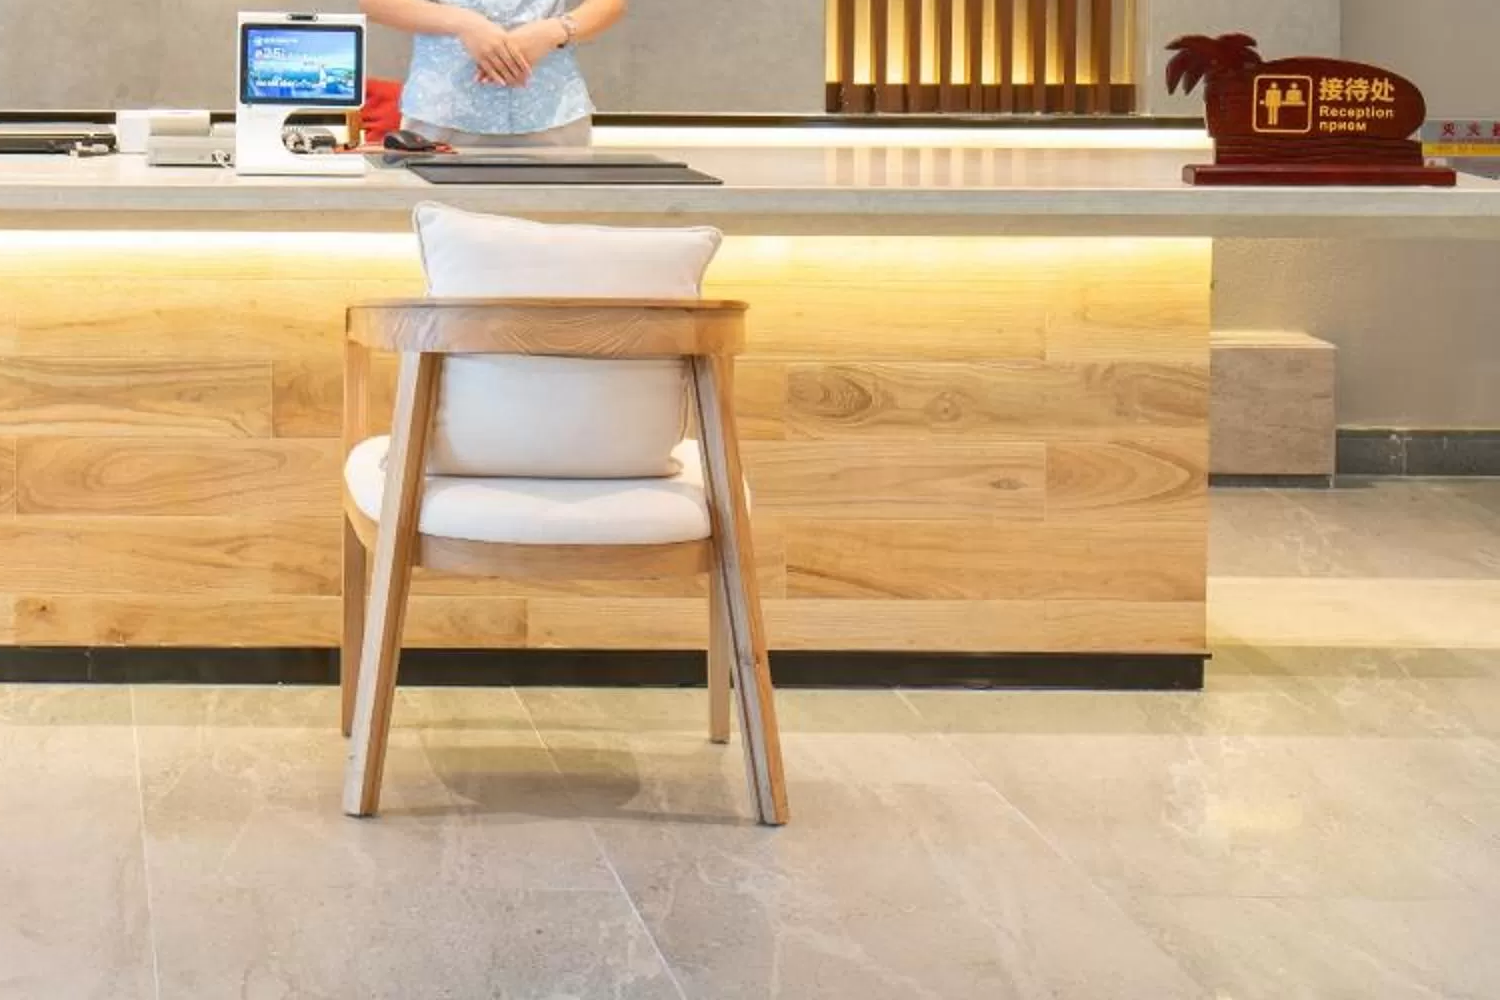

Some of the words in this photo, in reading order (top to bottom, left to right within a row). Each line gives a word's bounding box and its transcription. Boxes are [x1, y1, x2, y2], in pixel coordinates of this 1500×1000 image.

[1319, 77, 1395, 102] 接待处
[1319, 105, 1394, 120] Reception
